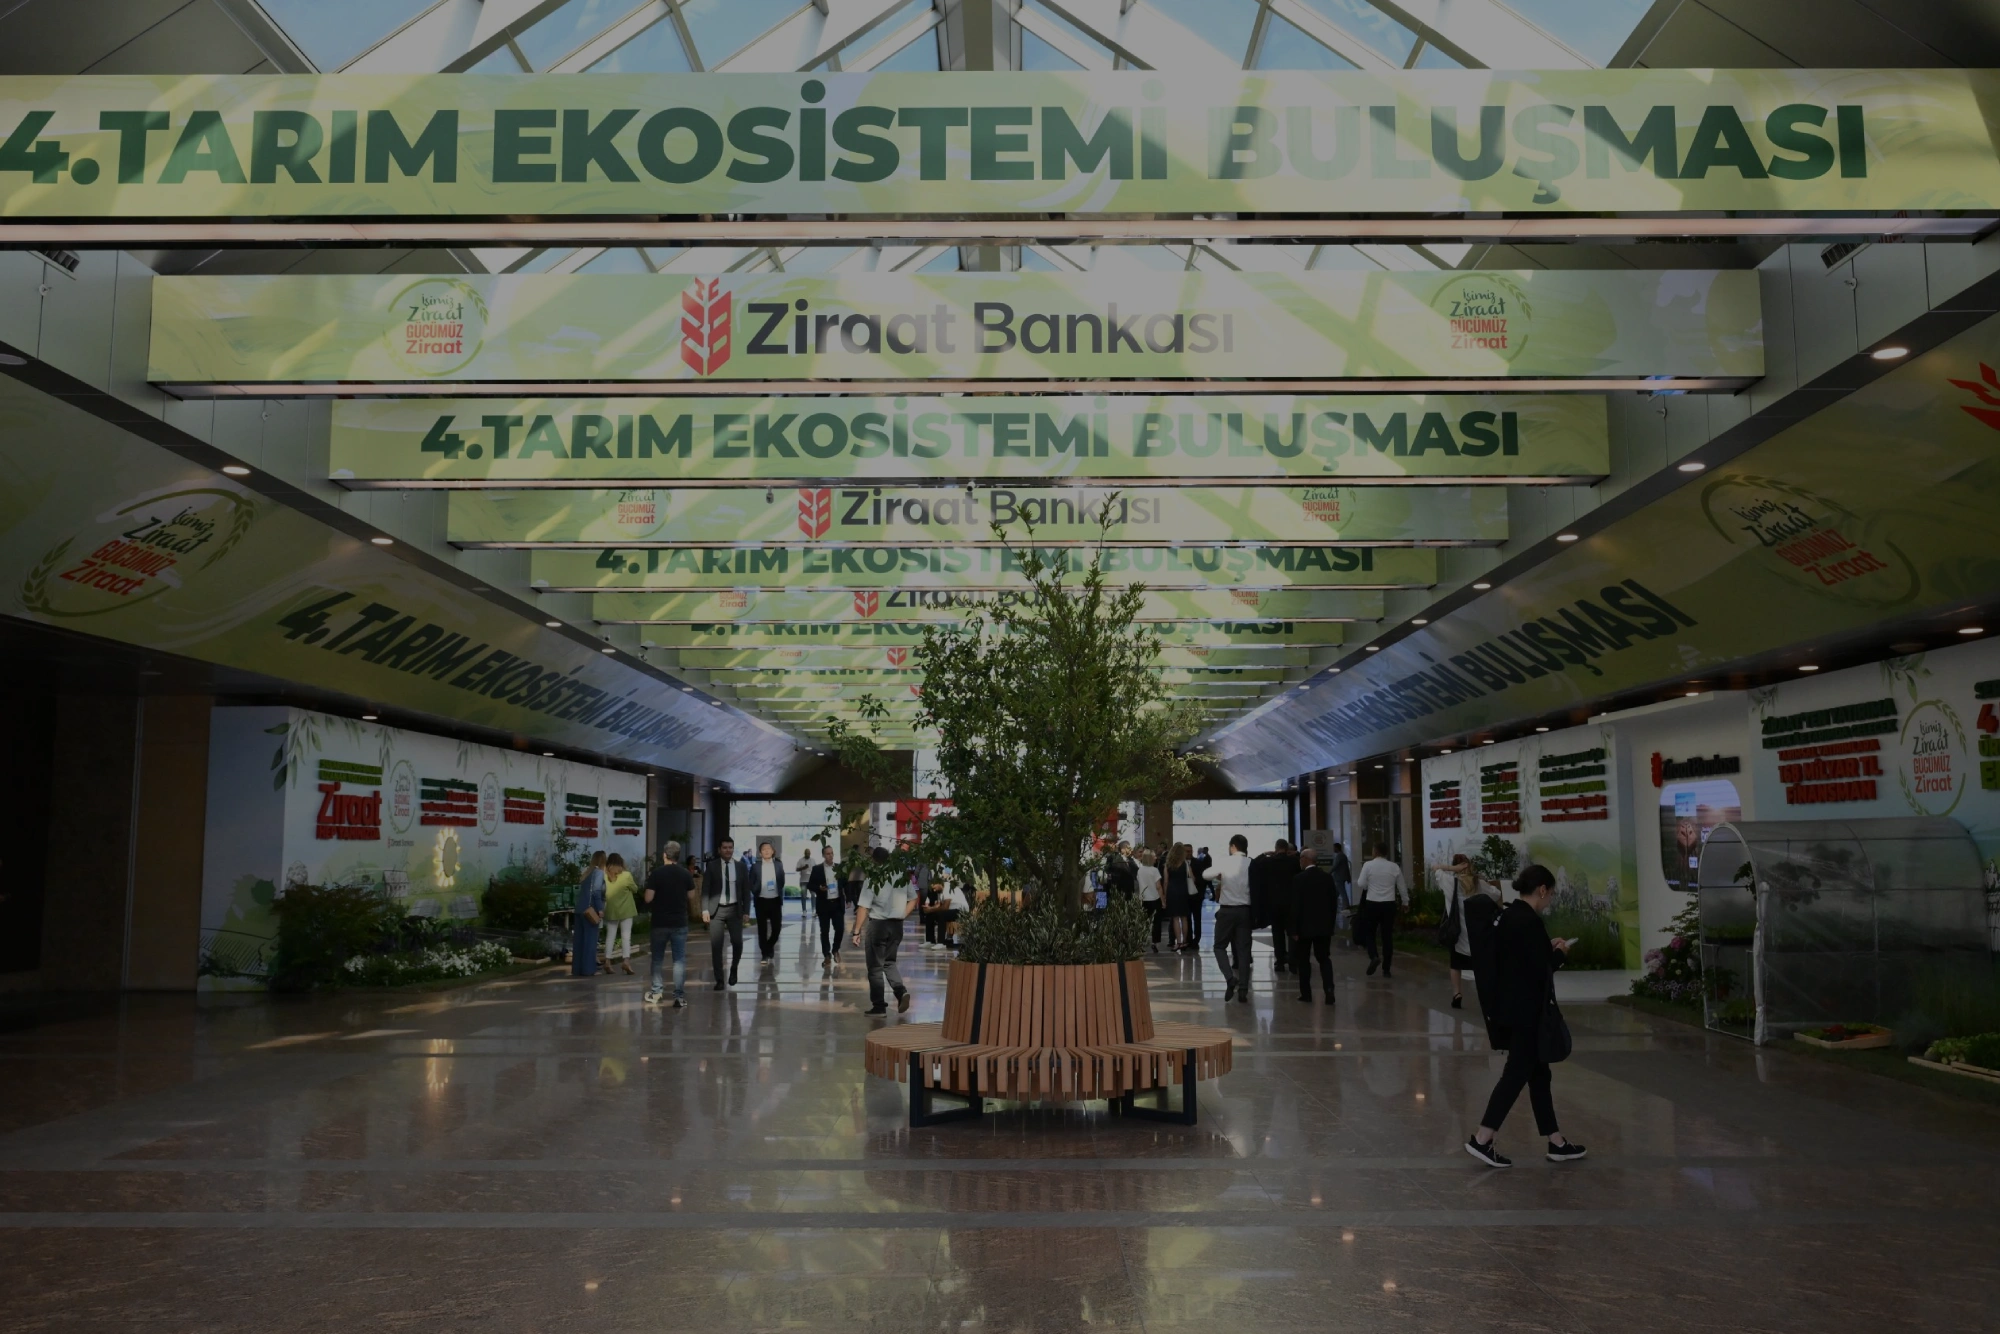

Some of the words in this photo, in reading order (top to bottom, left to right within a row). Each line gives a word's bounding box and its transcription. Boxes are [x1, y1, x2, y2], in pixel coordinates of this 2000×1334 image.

[0, 108, 458, 184] 4.TARIM
[492, 78, 1167, 183] EKOSİSTEMİ
[1207, 102, 1867, 204] BULUŞMASI
[406, 303, 464, 322] Ziraat
[1449, 297, 1506, 317] Ziraat
[406, 321, 463, 338] GÜCÜMÜZ
[746, 298, 955, 354] Ziraat
[973, 302, 1233, 354] Bankası
[1450, 316, 1507, 333] GÜCÜMÜZ
[406, 339, 463, 354] Ziraat
[1450, 334, 1507, 349] Ziraat
[421, 415, 692, 459] 4.TARIM
[713, 397, 1109, 458] EKOSİSTEMİ
[1133, 411, 1519, 472] BULUŞMASI
[617, 513, 655, 524] Ziraat
[841, 486, 978, 525] Ziraat
[990, 489, 1160, 525] Bankası
[1303, 511, 1340, 522] Ziraat
[122, 517, 214, 554] Ziraat
[1741, 502, 1819, 547] Ziraat
[91, 538, 177, 577] GÜCÜMÜZ
[1775, 528, 1857, 567] GÜCÜMÜZ
[58, 559, 146, 596] Ziraat
[1802, 549, 1889, 586] Ziraat
[277, 591, 489, 680] 4.TARIM
[448, 649, 639, 725] EKOSİSTEMİ
[1344, 651, 1487, 731] EKOSİSTEMİ
[1448, 578, 1698, 691] BULUŞMASI
[1913, 729, 1949, 755] Ziraat
[1802, 758, 1860, 781] MİLYAR
[1913, 752, 1951, 774] GÜCÜMÜZ
[1786, 779, 1877, 804] FİNANSMAN
[1914, 774, 1952, 793] Ziraat
[316, 781, 382, 827] Ziraat
